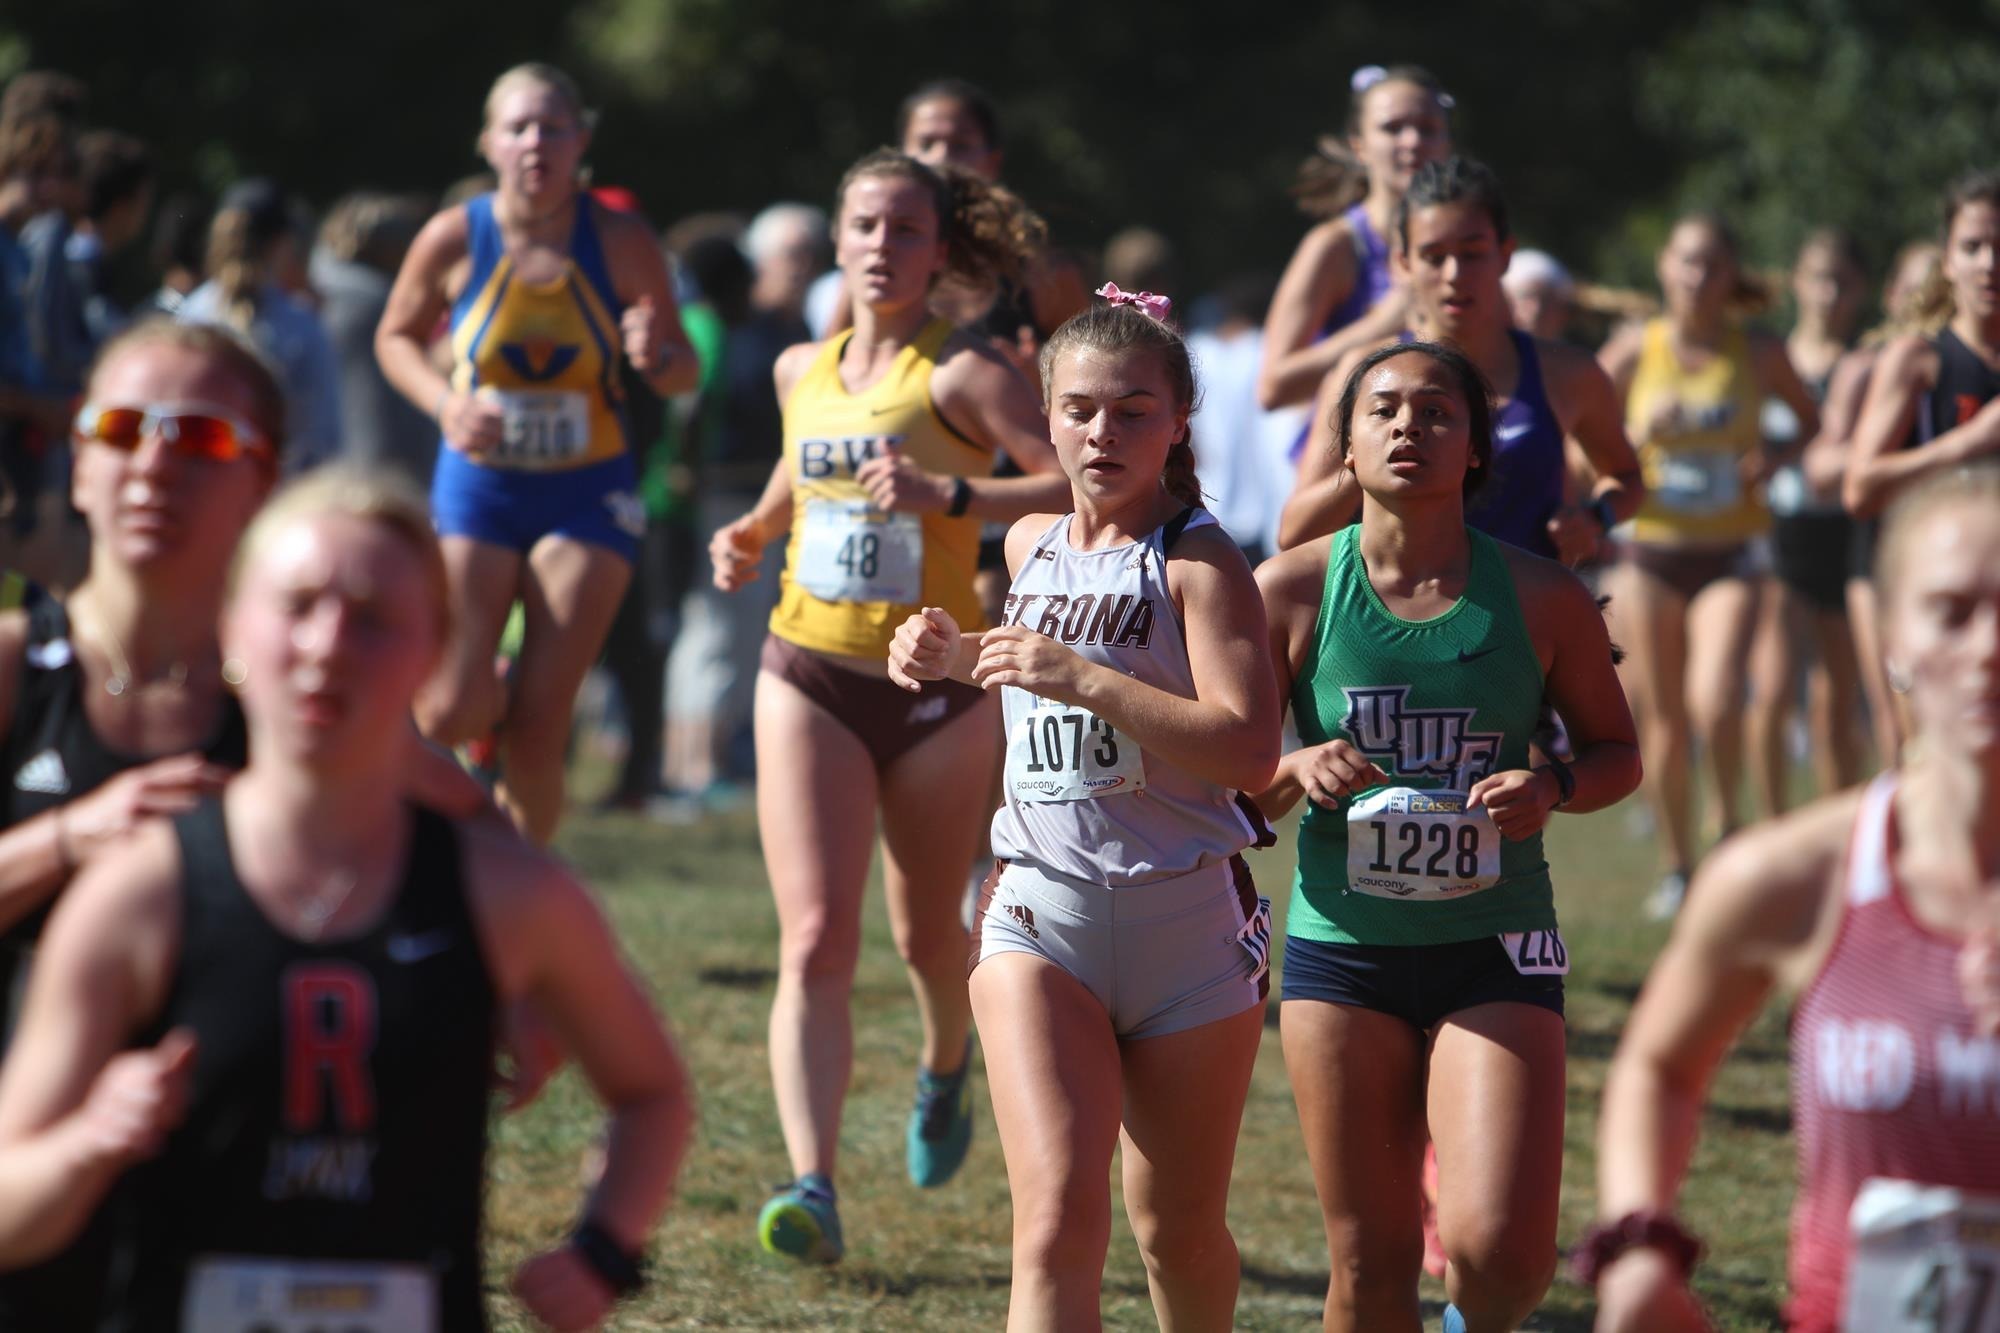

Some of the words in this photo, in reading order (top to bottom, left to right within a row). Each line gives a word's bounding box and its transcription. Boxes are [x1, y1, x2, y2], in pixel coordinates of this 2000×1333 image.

[837, 532, 879, 579] 48
[1036, 593, 1155, 650] BONA
[1027, 714, 1119, 772] 1073
[1339, 684, 1504, 790] UWF
[1016, 781, 1055, 791] saucony
[1411, 801, 1462, 812] CLASSIC
[1369, 821, 1479, 880] 1228
[1357, 877, 1405, 890] saucony
[1503, 929, 1566, 968] 228
[283, 961, 379, 1132] R
